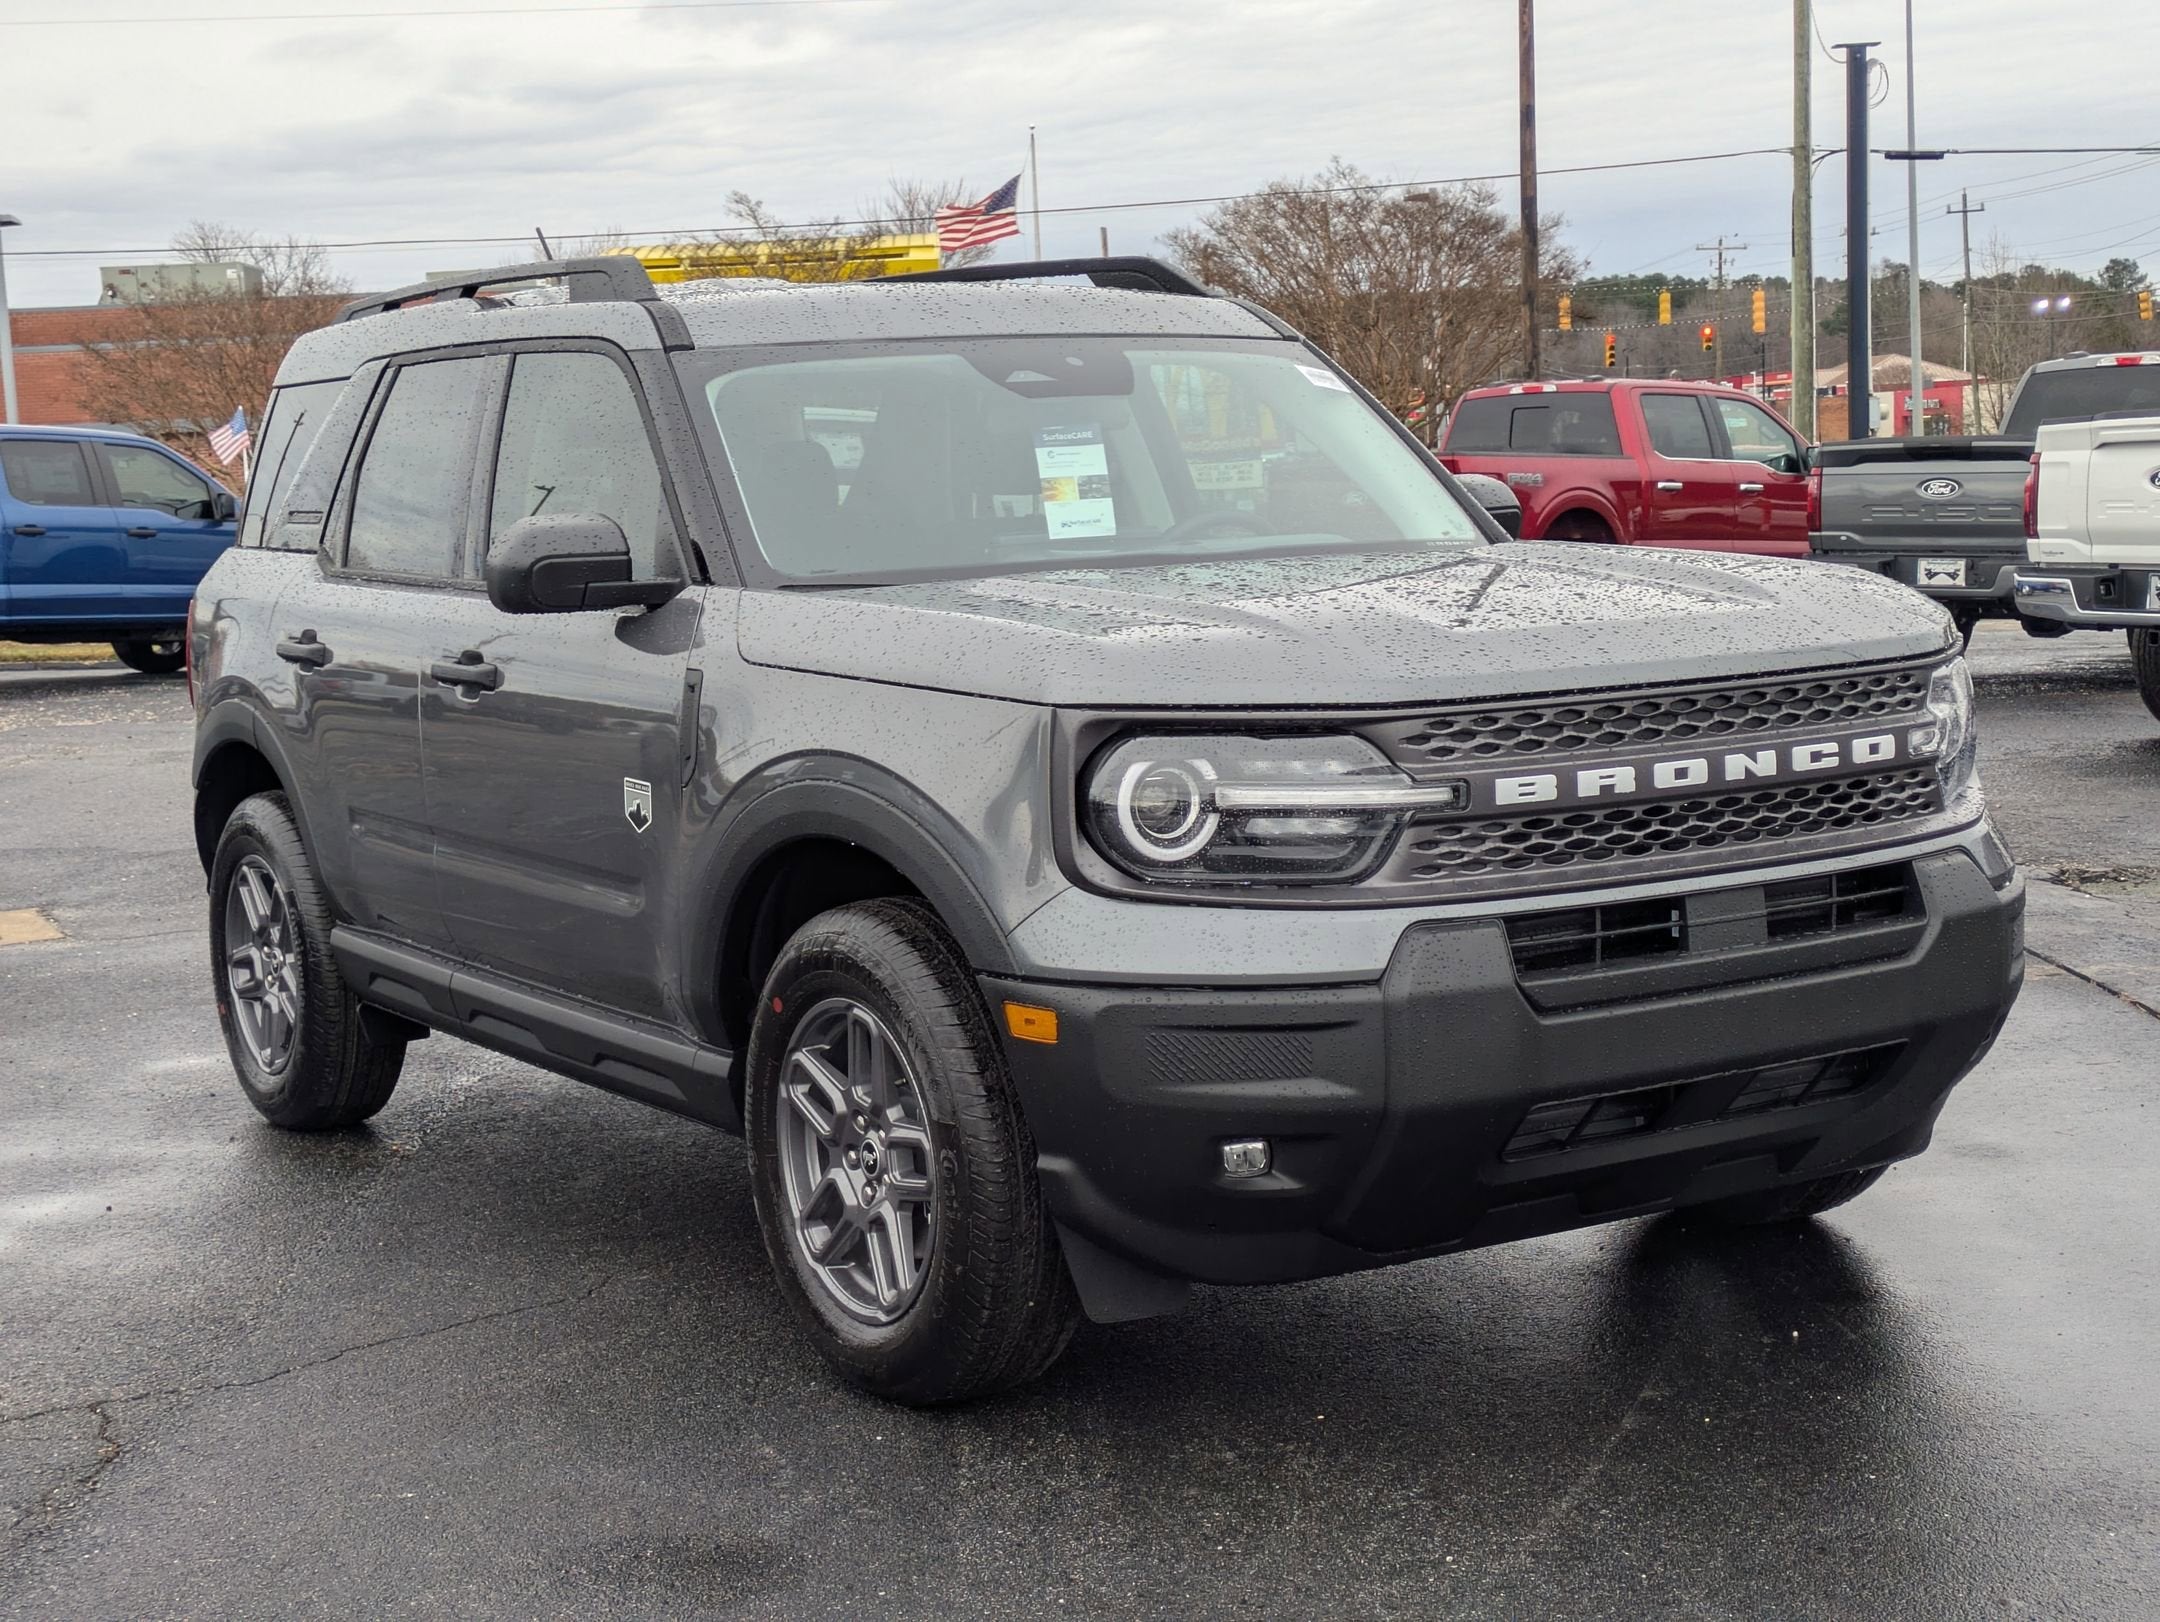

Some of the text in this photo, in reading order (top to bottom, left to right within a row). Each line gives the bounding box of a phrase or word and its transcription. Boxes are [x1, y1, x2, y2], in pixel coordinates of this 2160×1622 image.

[1042, 430, 1095, 441] SurfaceCARE
[1507, 472, 1544, 487] FX4
[1927, 482, 1953, 495] Ford
[1861, 503, 2022, 522] F-150
[1495, 733, 1896, 807] BRONCO
